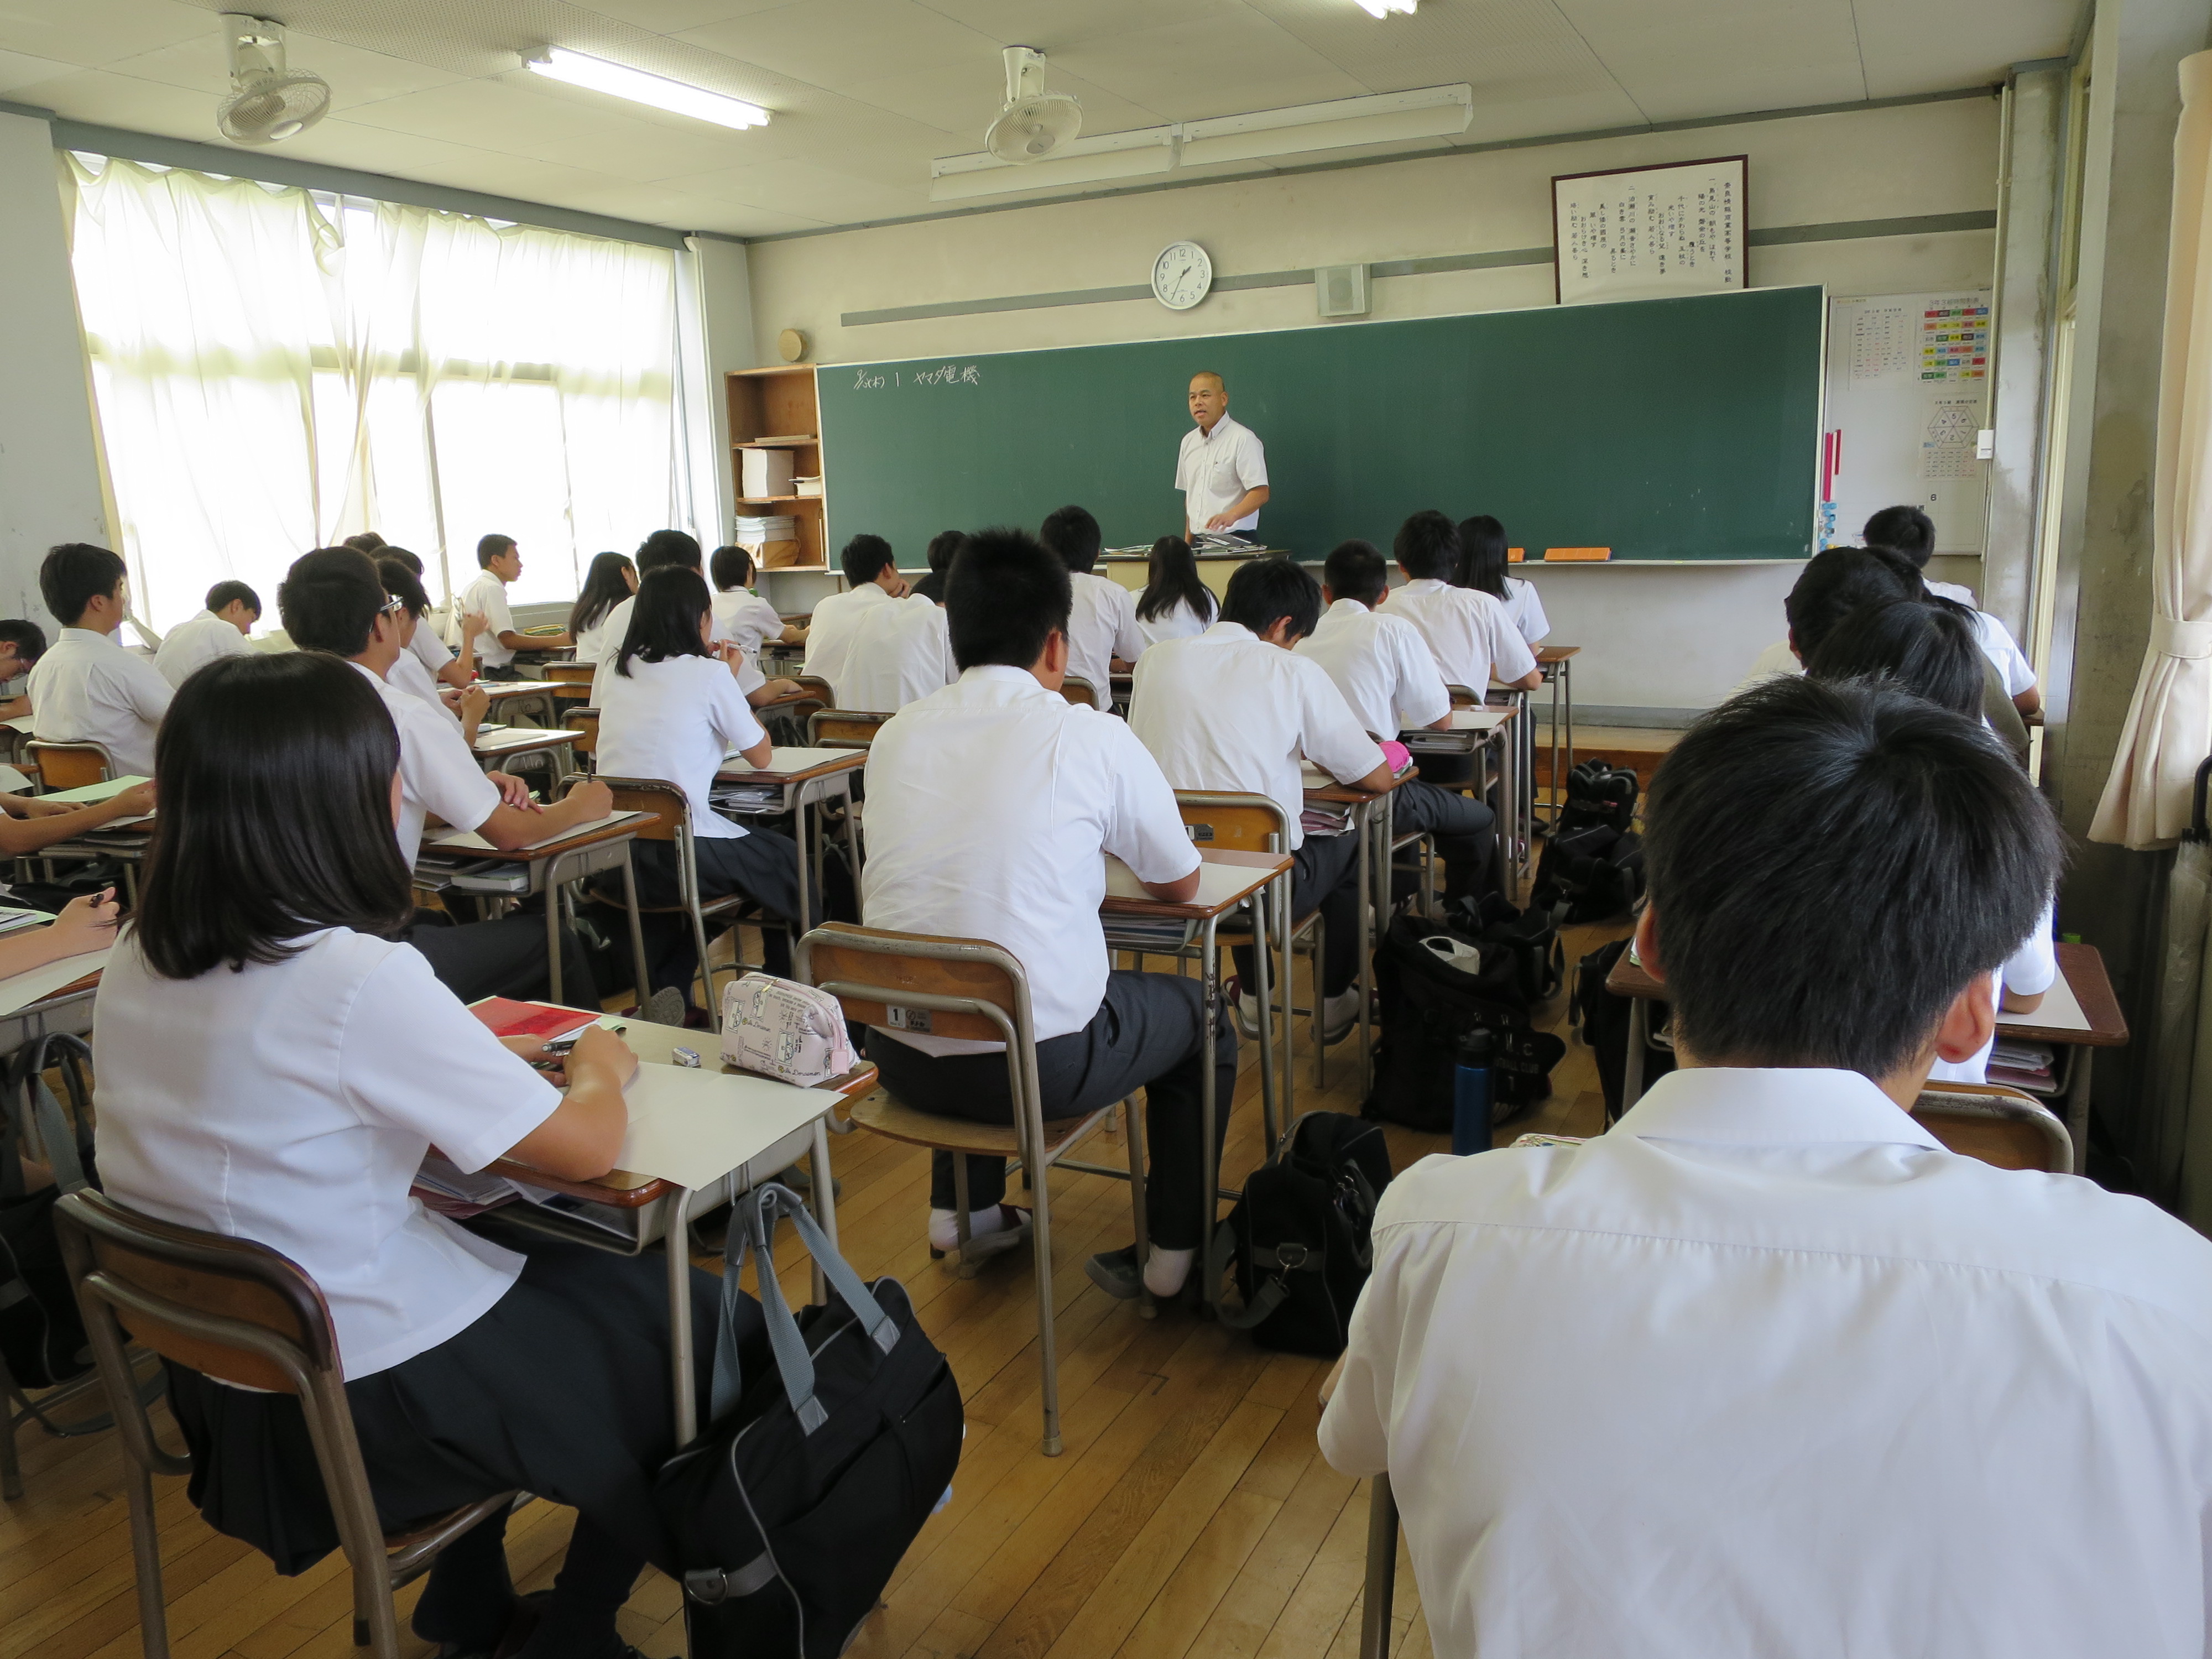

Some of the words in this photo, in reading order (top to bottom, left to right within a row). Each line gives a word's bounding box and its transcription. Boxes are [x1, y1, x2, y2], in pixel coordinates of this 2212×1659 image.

[1170, 252, 1176, 260] 11
[1179, 248, 1186, 257] 12
[1162, 261, 1170, 269] 10
[1197, 258, 1203, 267] 2
[1160, 273, 1165, 281] 9
[1200, 269, 1206, 278] 3
[1162, 284, 1168, 293] 8
[1179, 294, 1185, 302] 6
[1190, 290, 1195, 299] 5
[912, 364, 980, 385] ヤマダ電機
[893, 1008, 899, 1021] 1
